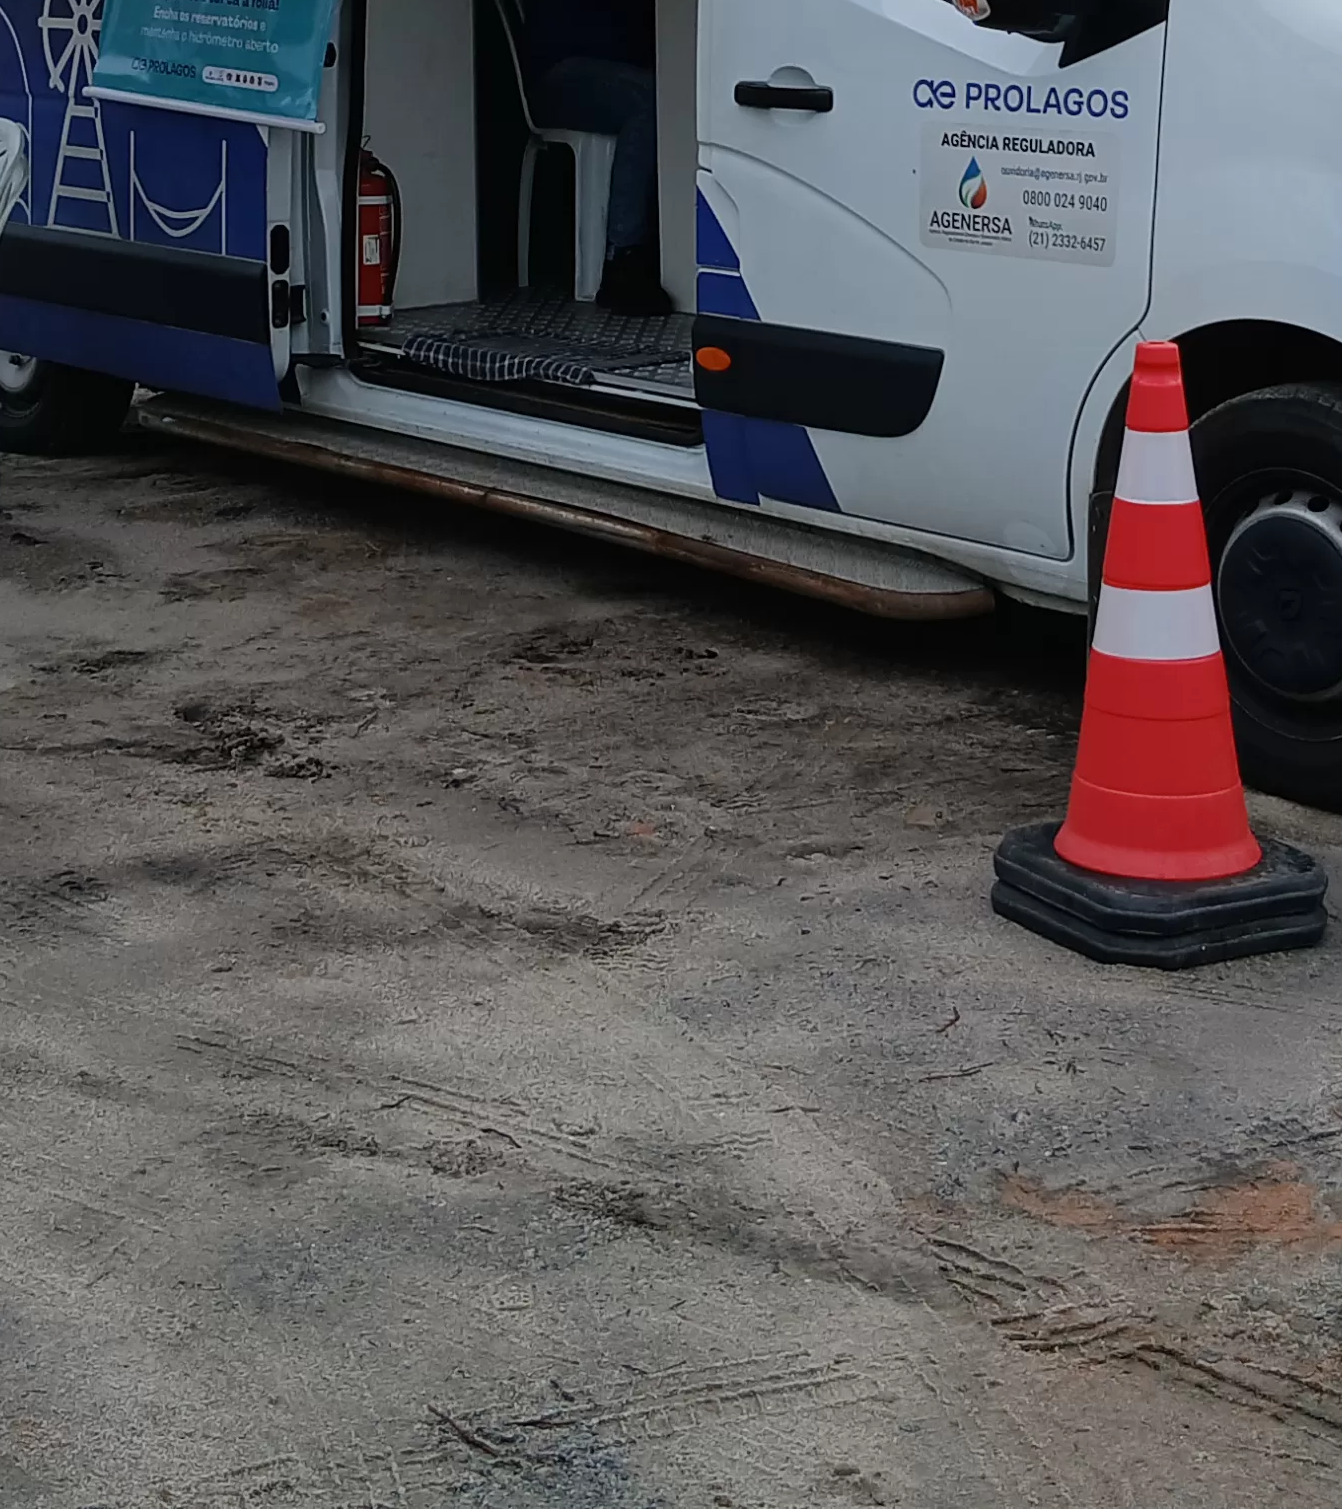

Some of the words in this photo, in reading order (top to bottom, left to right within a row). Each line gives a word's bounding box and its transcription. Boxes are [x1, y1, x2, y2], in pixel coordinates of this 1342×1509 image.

[191, 14, 258, 31] reservatórios
[189, 30, 243, 48] hidrômetro
[245, 39, 279, 54] aberto
[148, 59, 197, 79] PROLAGOS
[965, 81, 1130, 119] PROLAGOS
[941, 130, 999, 152] AGÊNCIA
[1002, 137, 1096, 158] REGULADORA
[1022, 190, 1052, 207] 0800
[1054, 192, 1076, 209] 024
[1078, 194, 1108, 212] 9040
[929, 210, 1013, 235] AGENERSA
[1029, 229, 1049, 249] (21)
[1051, 232, 1106, 252] 2332-6457
